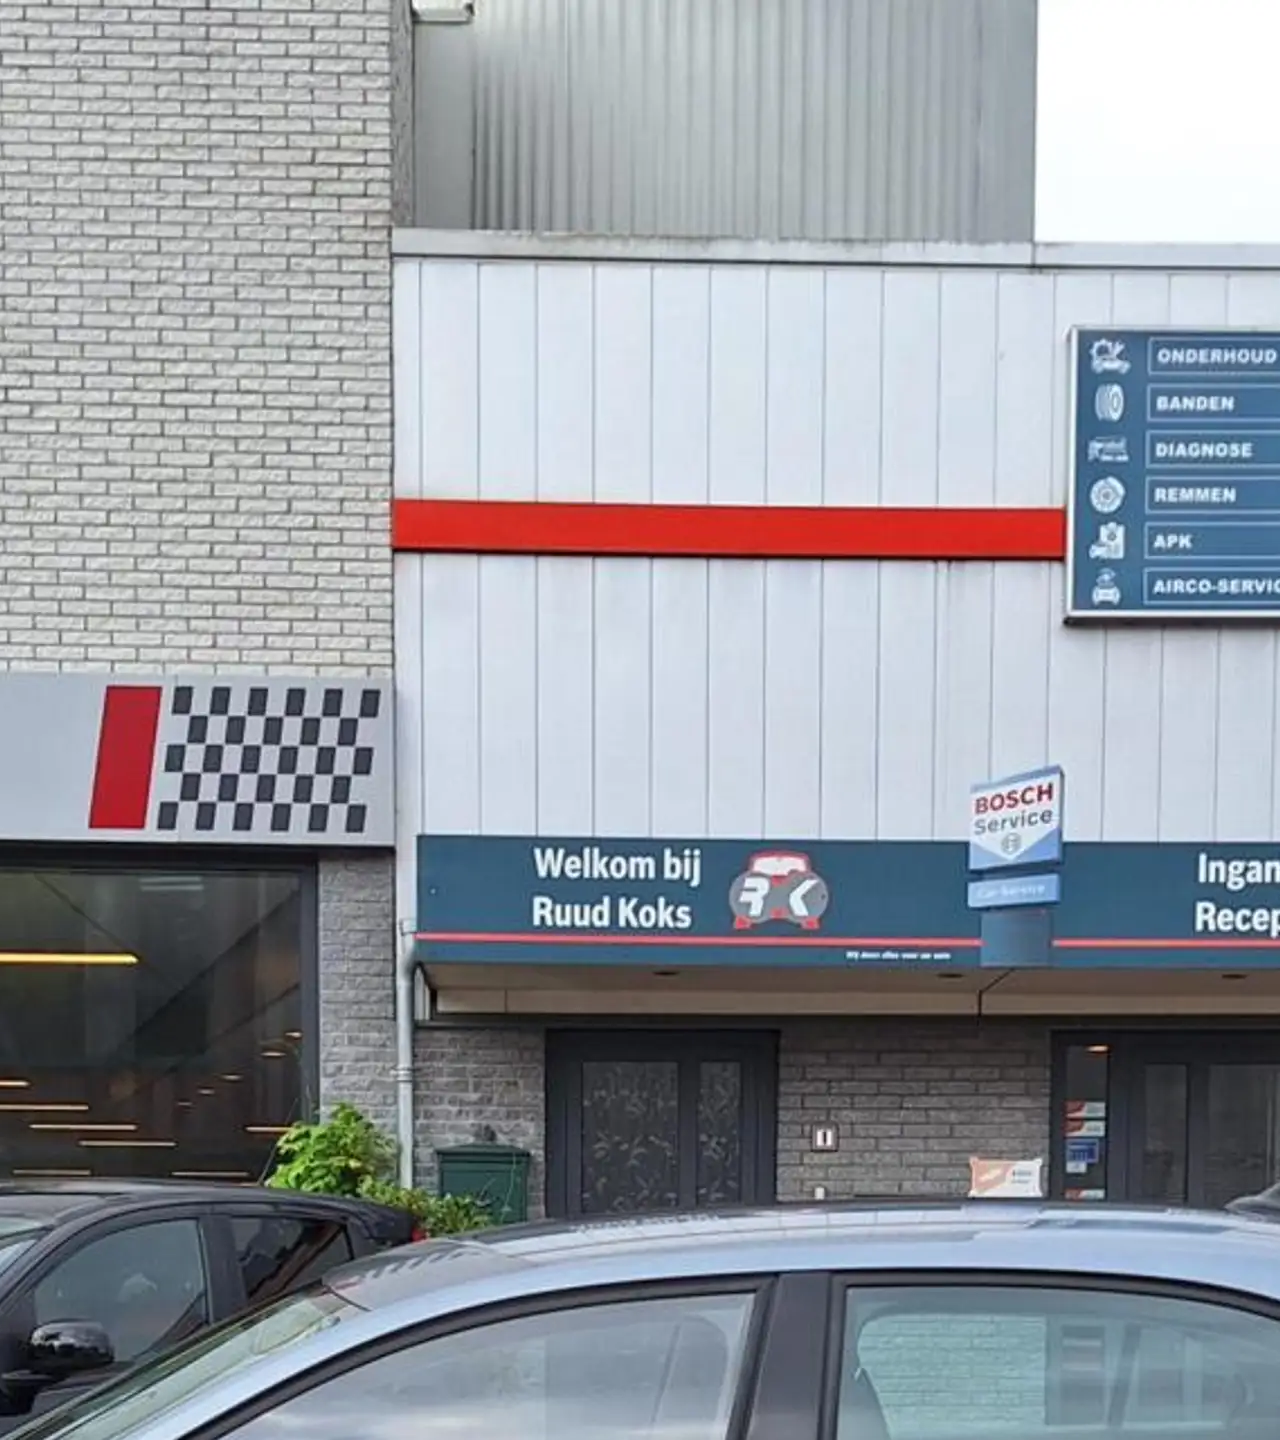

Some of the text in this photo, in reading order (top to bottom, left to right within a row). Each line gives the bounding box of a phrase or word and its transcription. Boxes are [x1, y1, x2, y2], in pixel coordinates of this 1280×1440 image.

[1157, 349, 1277, 363] ONDERHOUD
[1156, 396, 1234, 411] BANDEN
[1155, 443, 1253, 457] DIAGNOSE
[1154, 487, 1236, 501] REMMEN
[1153, 534, 1192, 549] APK
[975, 783, 1053, 814] BOSCH
[974, 810, 1053, 835] Service
[534, 848, 702, 887] Welkom bij
[533, 897, 692, 930] Ruud Koks
